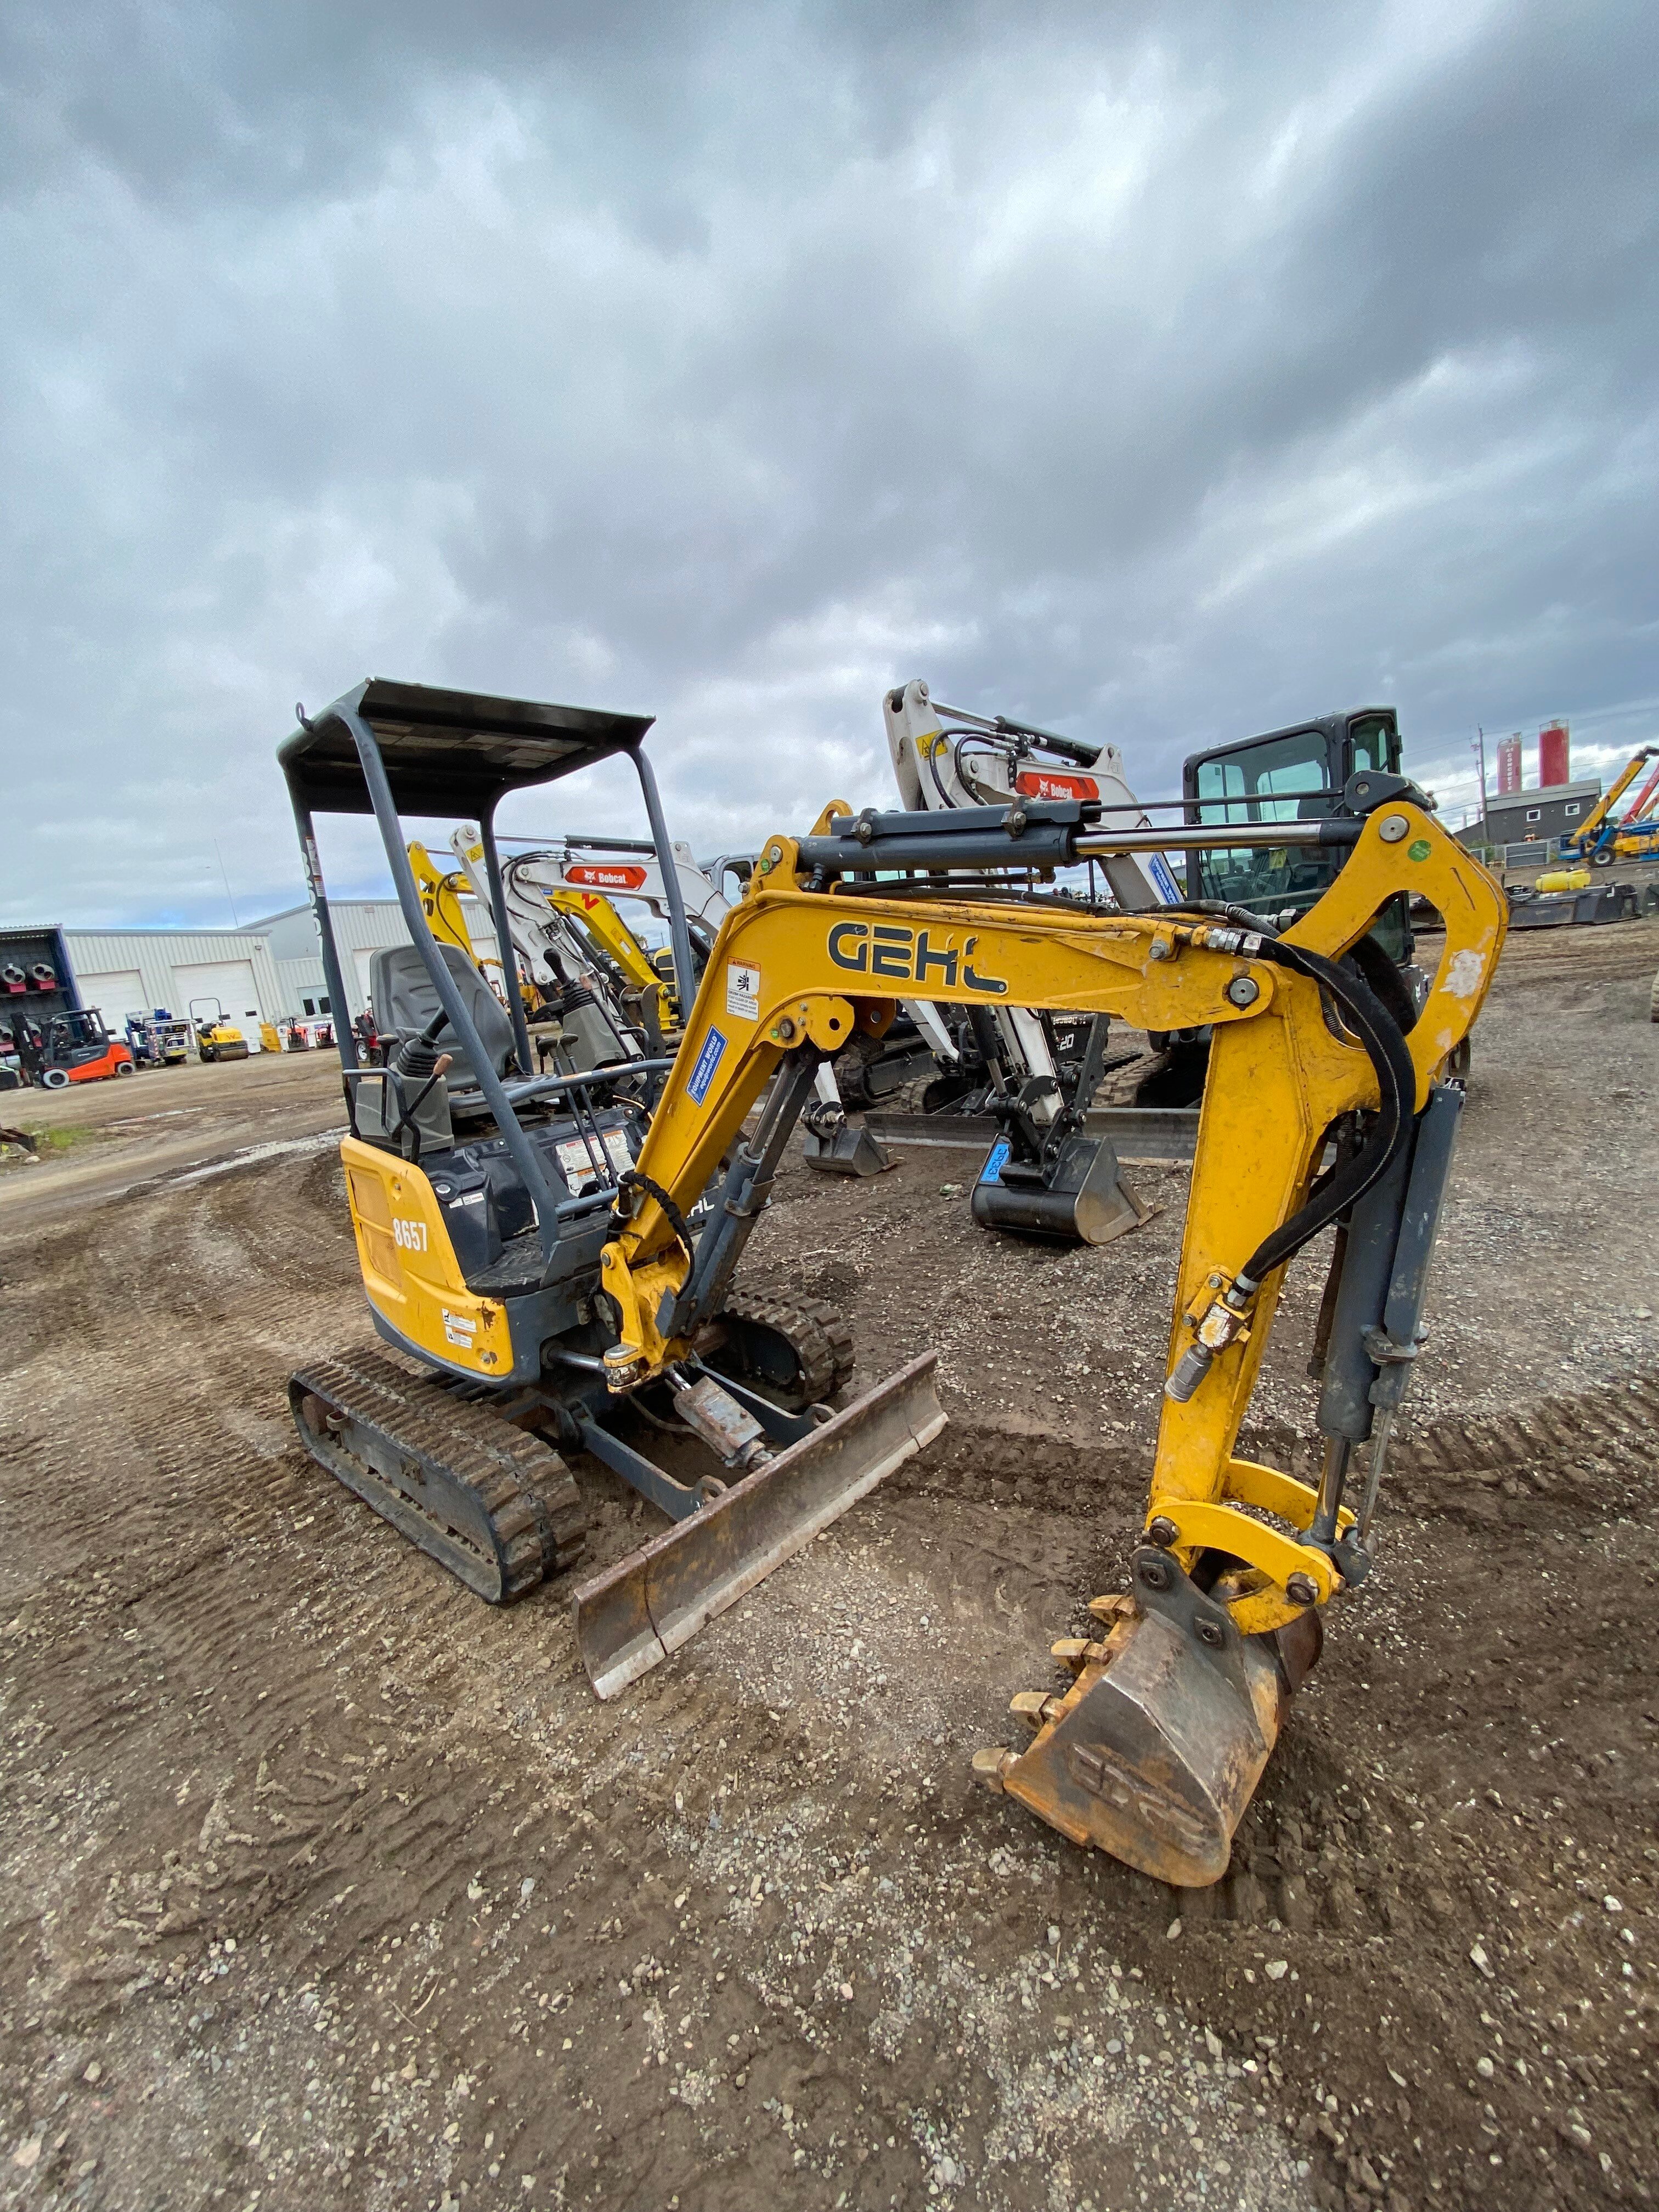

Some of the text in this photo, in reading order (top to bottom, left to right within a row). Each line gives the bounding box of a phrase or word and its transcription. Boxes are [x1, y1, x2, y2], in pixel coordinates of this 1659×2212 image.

[1051, 783, 1073, 799] Bobcat
[598, 872, 626, 884] Bobcat
[737, 960, 755, 969] WARNING
[827, 920, 1008, 995] GEHL
[1056, 1034, 1074, 1051] 20
[691, 1036, 718, 1094] EQUIPMENT WORLD
[700, 1041, 721, 1089] equipworld.com
[393, 1218, 427, 1252] 8657
